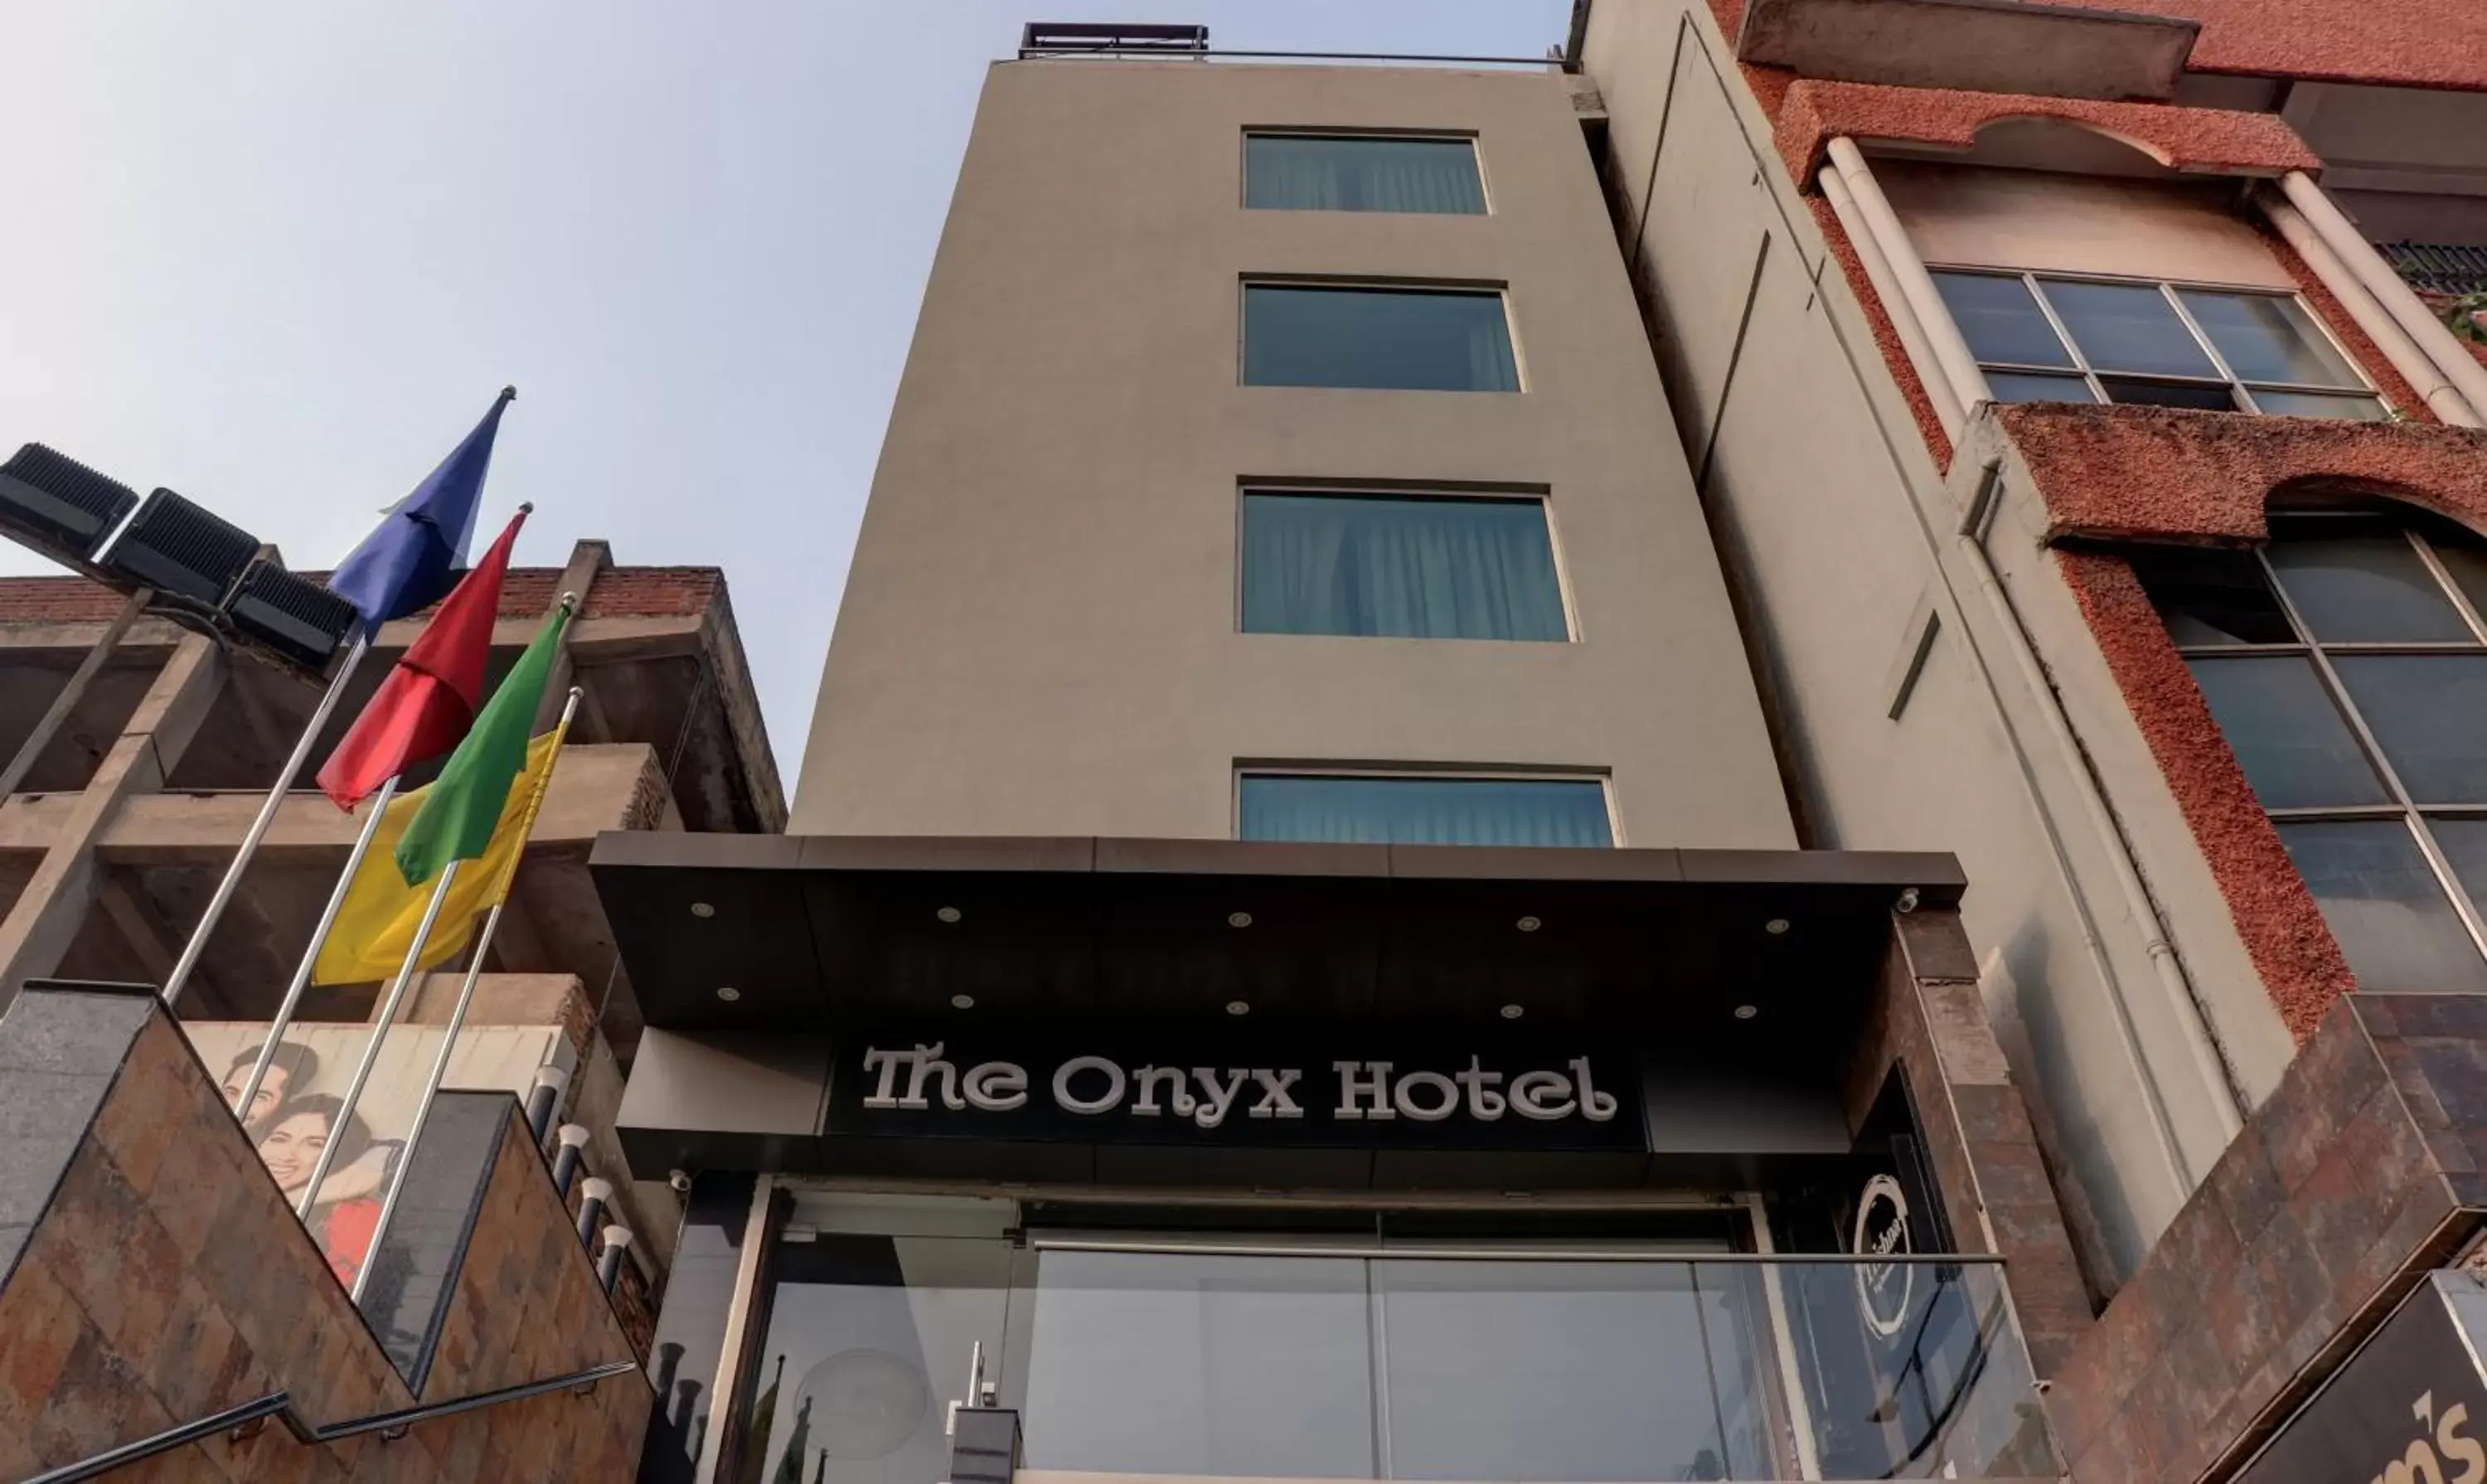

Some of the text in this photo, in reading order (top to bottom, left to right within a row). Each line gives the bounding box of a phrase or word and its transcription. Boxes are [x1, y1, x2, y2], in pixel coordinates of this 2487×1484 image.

[863, 1041, 1617, 1128] The Onyx Hotel
